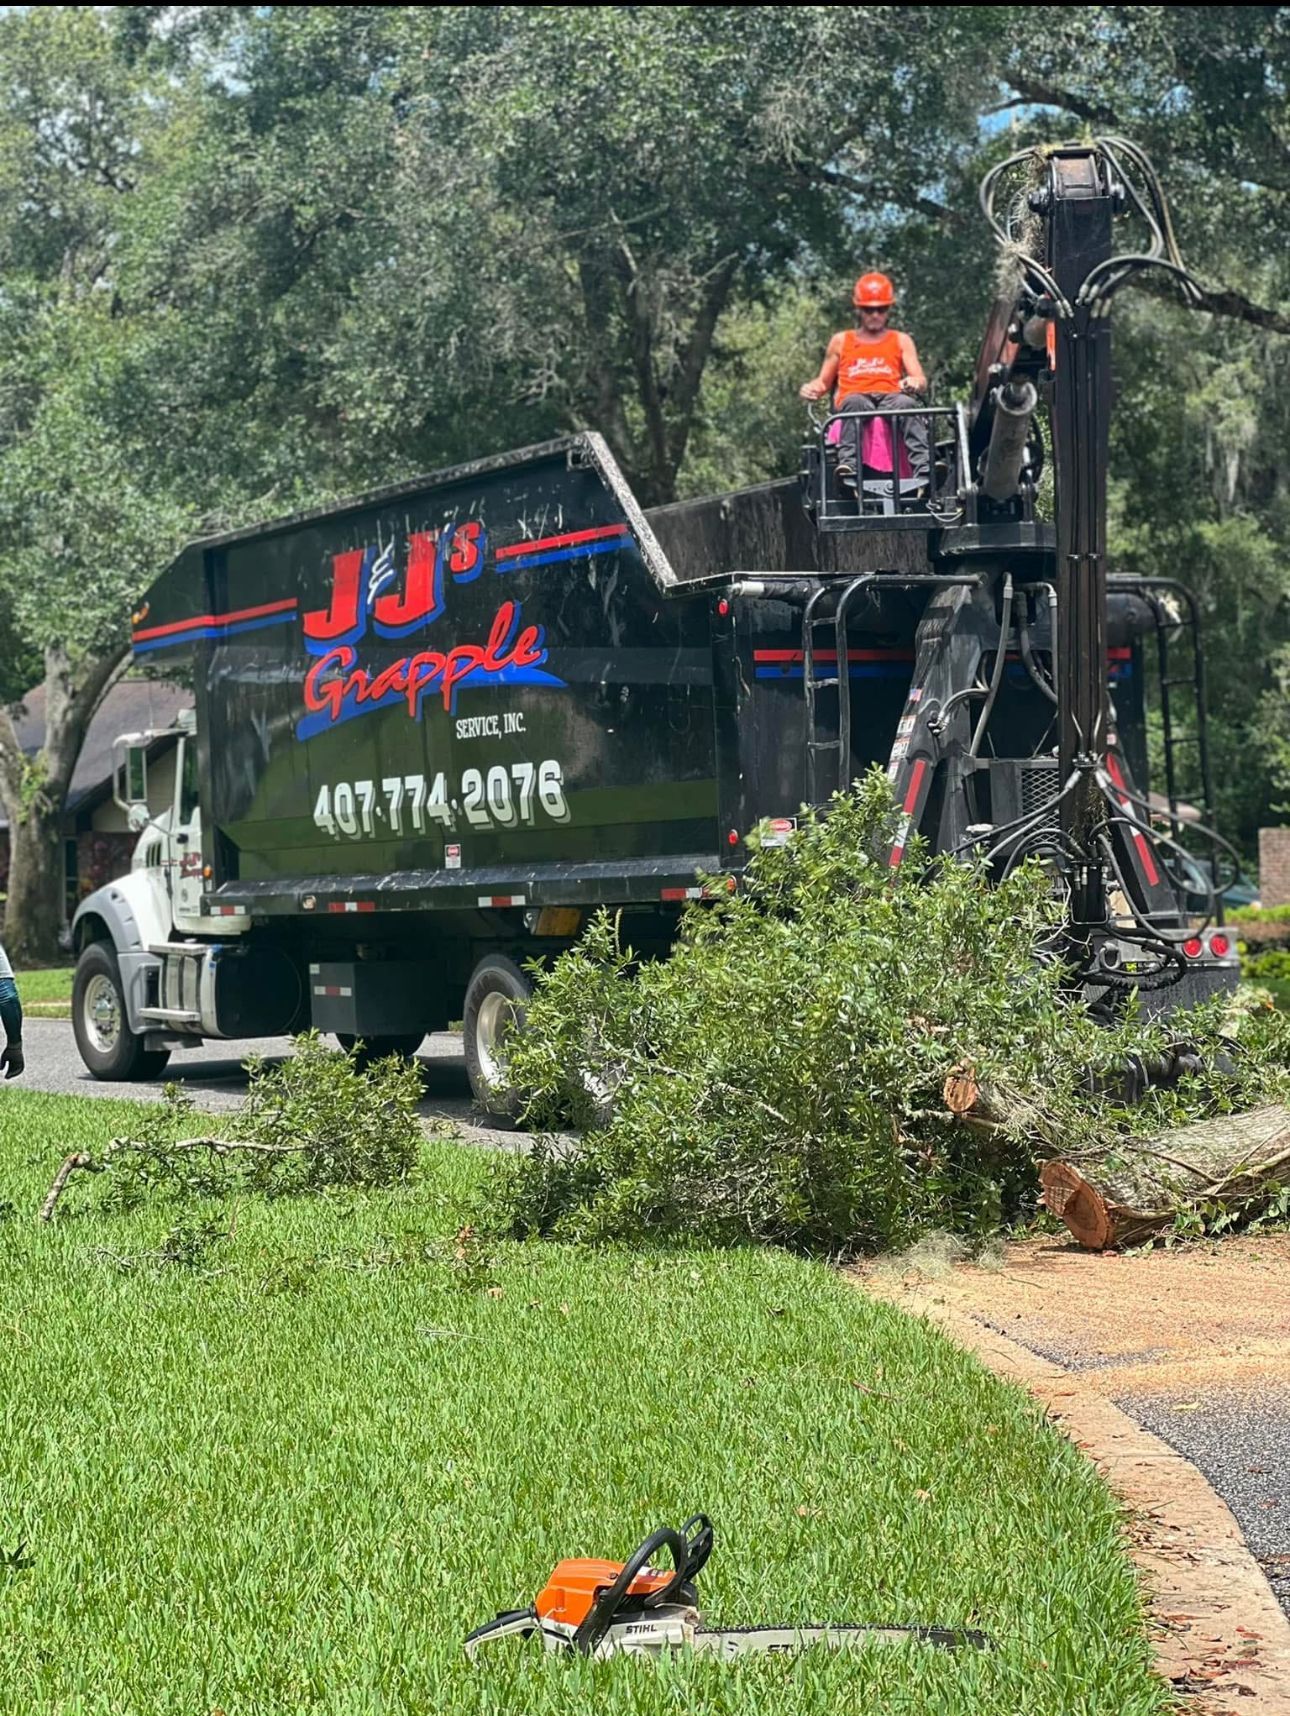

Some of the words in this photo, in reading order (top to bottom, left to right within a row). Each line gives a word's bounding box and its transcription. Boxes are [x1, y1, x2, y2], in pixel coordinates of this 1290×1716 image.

[303, 601, 543, 721] Grapple
[456, 715, 502, 740] SERVICE,
[503, 712, 527, 734] INC.
[626, 1624, 657, 1634] STIHL
